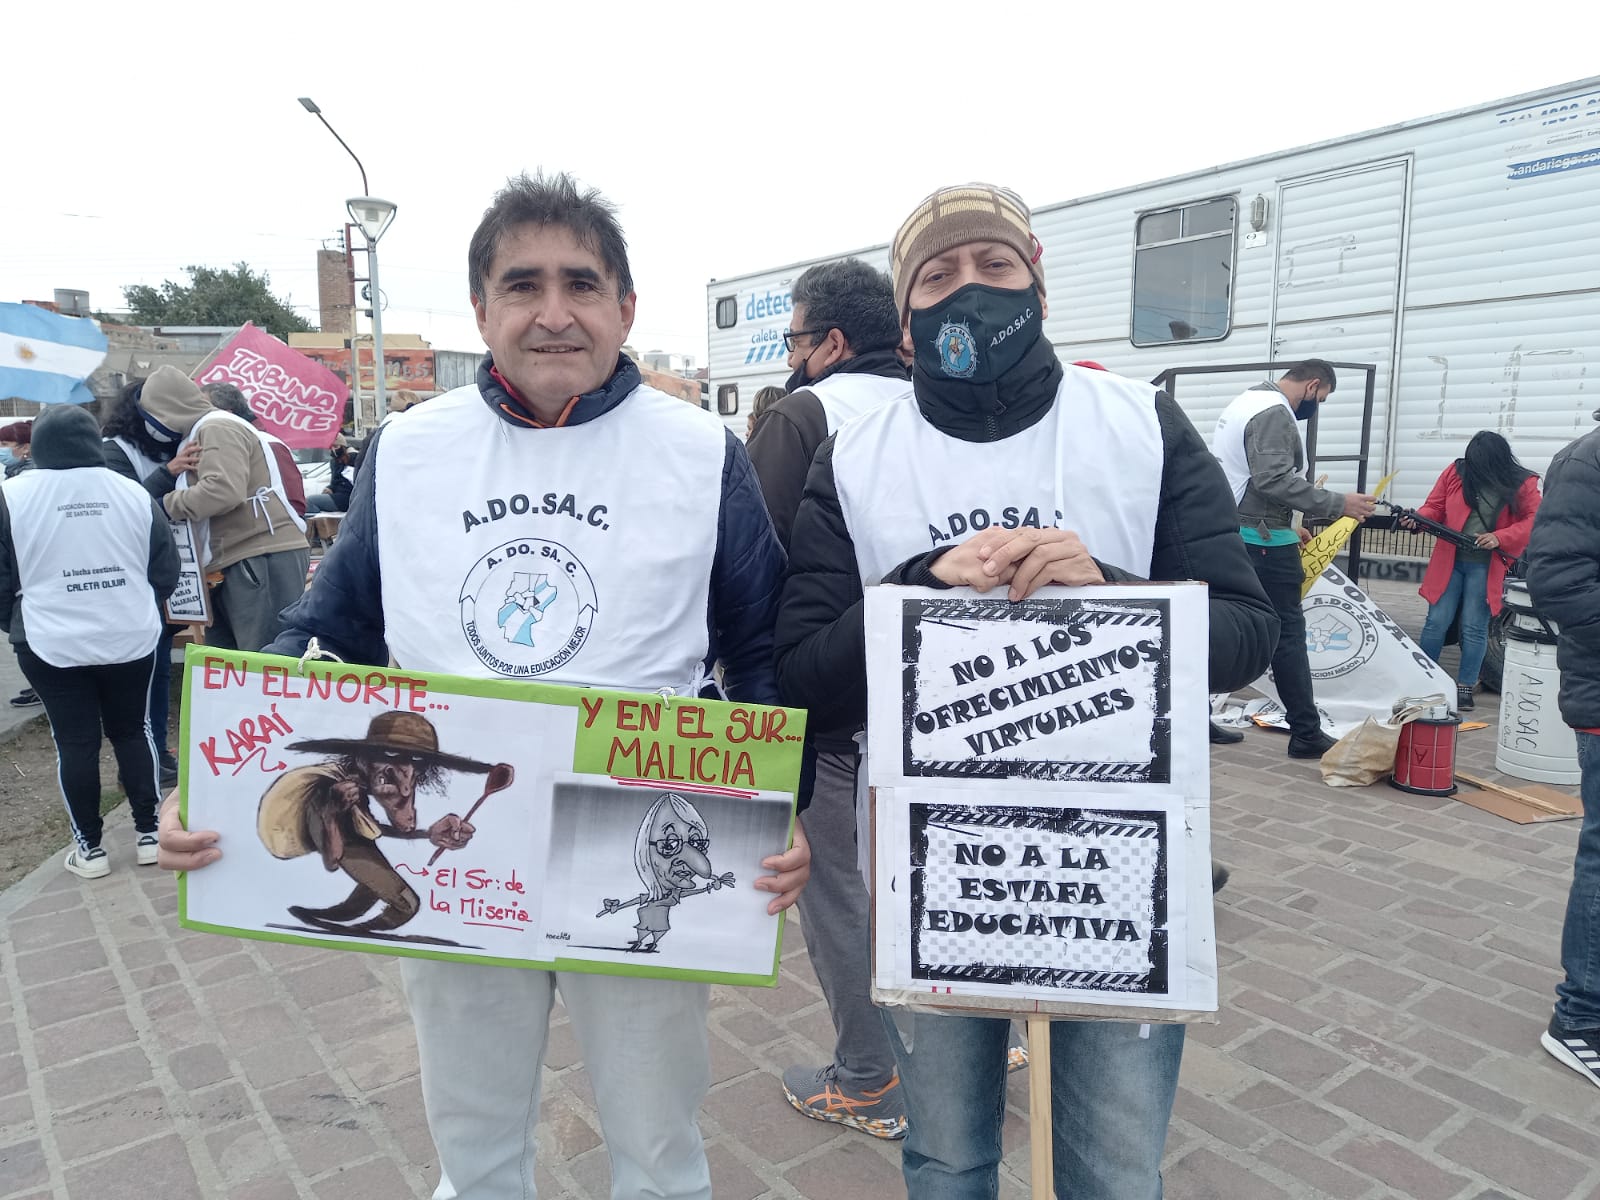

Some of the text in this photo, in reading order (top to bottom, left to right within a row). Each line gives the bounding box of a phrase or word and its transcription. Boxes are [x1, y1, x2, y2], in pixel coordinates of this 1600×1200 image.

[990, 308, 1034, 347] A.DO.SA.C.
[462, 493, 610, 533] A.DO.SA.C.
[66, 582, 100, 592] CALETA
[476, 645, 499, 668] JUNTOS
[498, 662, 513, 674] POR
[513, 665, 530, 675] UNA
[568, 626, 587, 651] MEJOR
[950, 623, 1093, 687] NO A LOS
[203, 656, 449, 713] EN EL NORTE...
[914, 638, 1163, 735] OFRECIMIENTOS
[581, 697, 802, 744] Y EN EL SUR...
[963, 687, 1135, 757] VIRTUALES
[606, 736, 756, 787] MALICIA
[953, 843, 1111, 871] NO A LA
[504, 869, 526, 895] de
[957, 877, 1106, 905] ESTAFA
[925, 909, 1143, 942] EDUCATIVA
